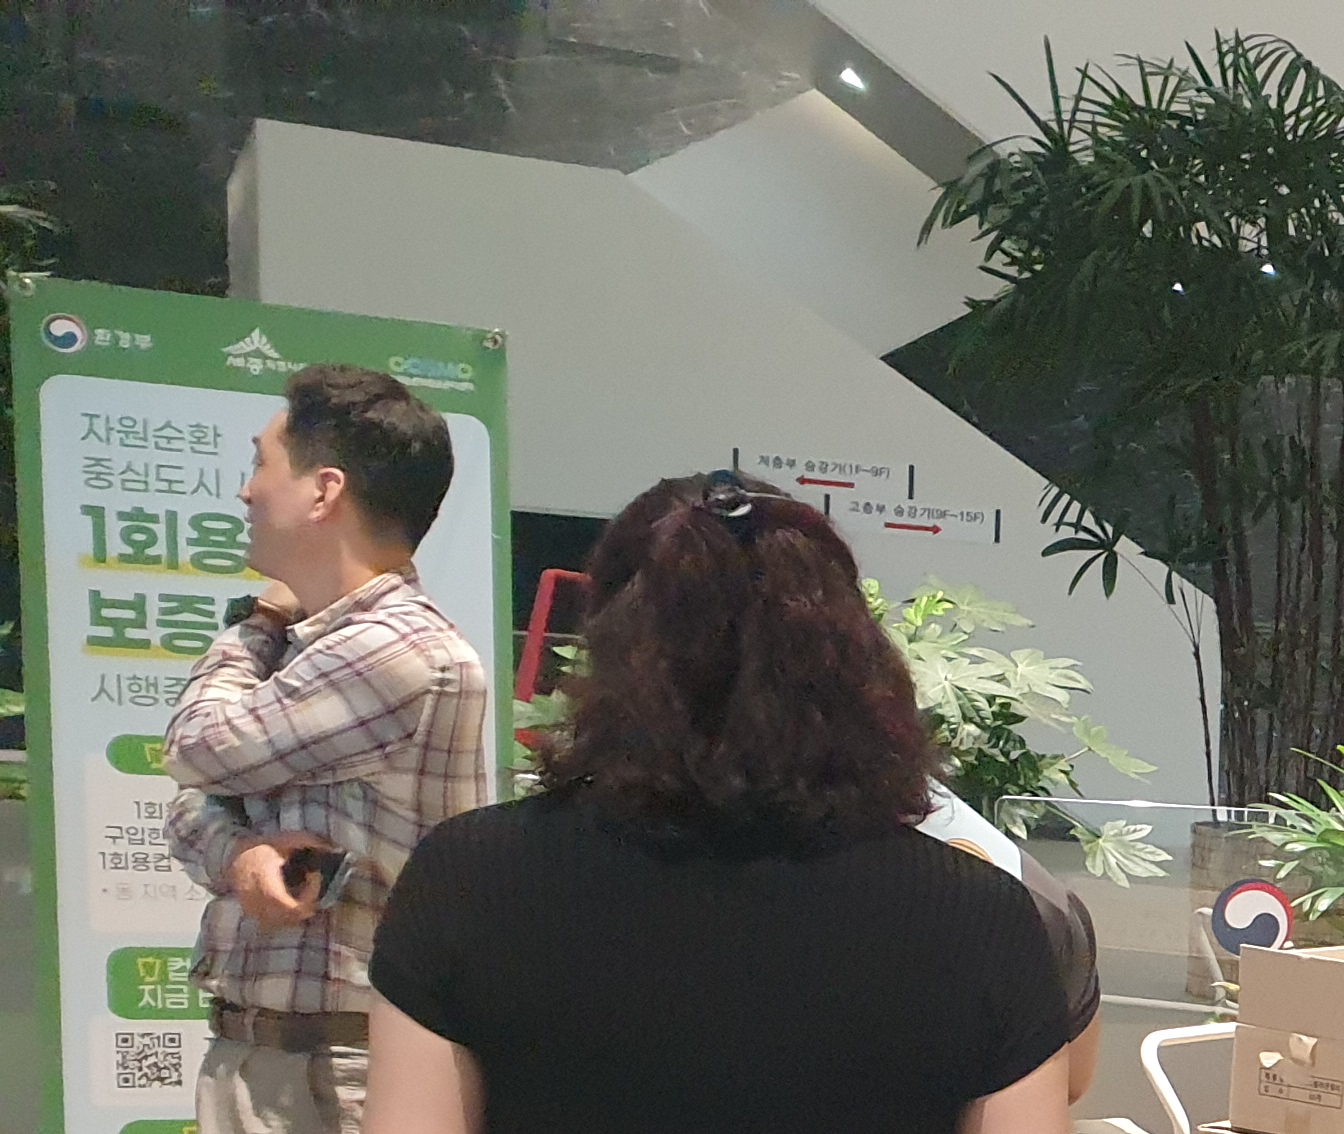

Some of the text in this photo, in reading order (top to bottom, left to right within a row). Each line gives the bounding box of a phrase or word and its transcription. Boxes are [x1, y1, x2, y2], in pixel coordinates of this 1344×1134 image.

[80, 412, 222, 455] 자원순환
[82, 456, 220, 498] 중심도시
[134, 801, 172, 820] 1회
[99, 851, 172, 872] 1회용컵
